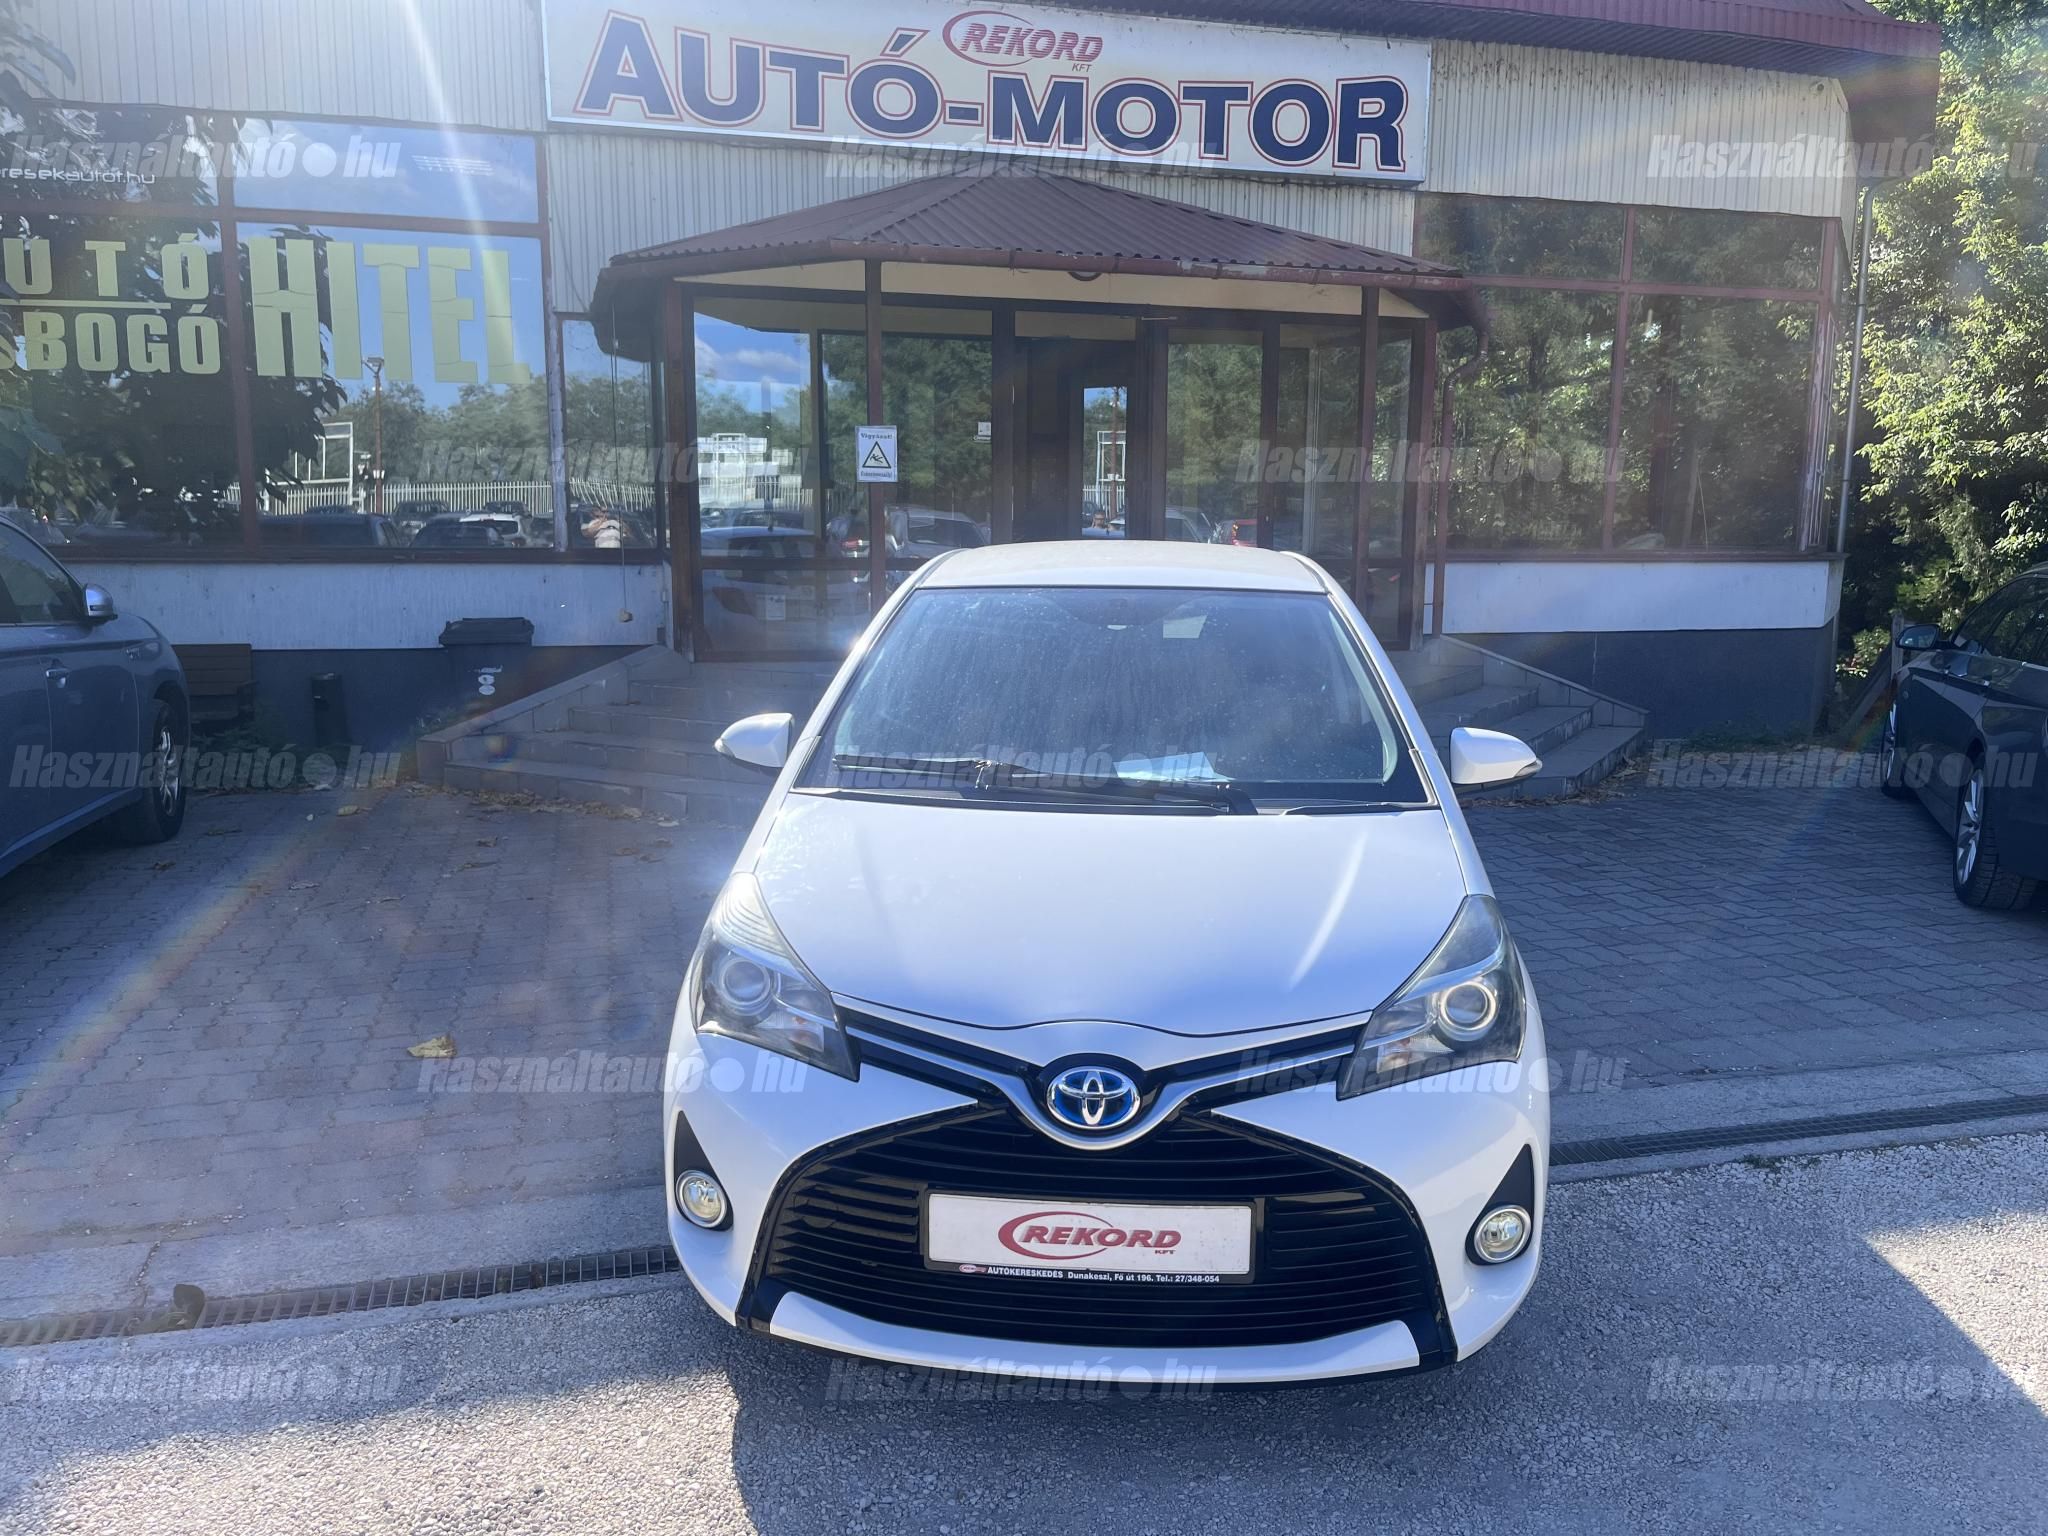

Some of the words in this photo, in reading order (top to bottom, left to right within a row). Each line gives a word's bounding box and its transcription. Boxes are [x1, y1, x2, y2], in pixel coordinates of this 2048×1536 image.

[959, 22, 1103, 62] REKORD
[1071, 63, 1092, 73] KFT
[0, 167, 156, 184] resekautot.hu
[248, 236, 531, 385] HITEL
[1020, 1225, 1182, 1248] REKORD
